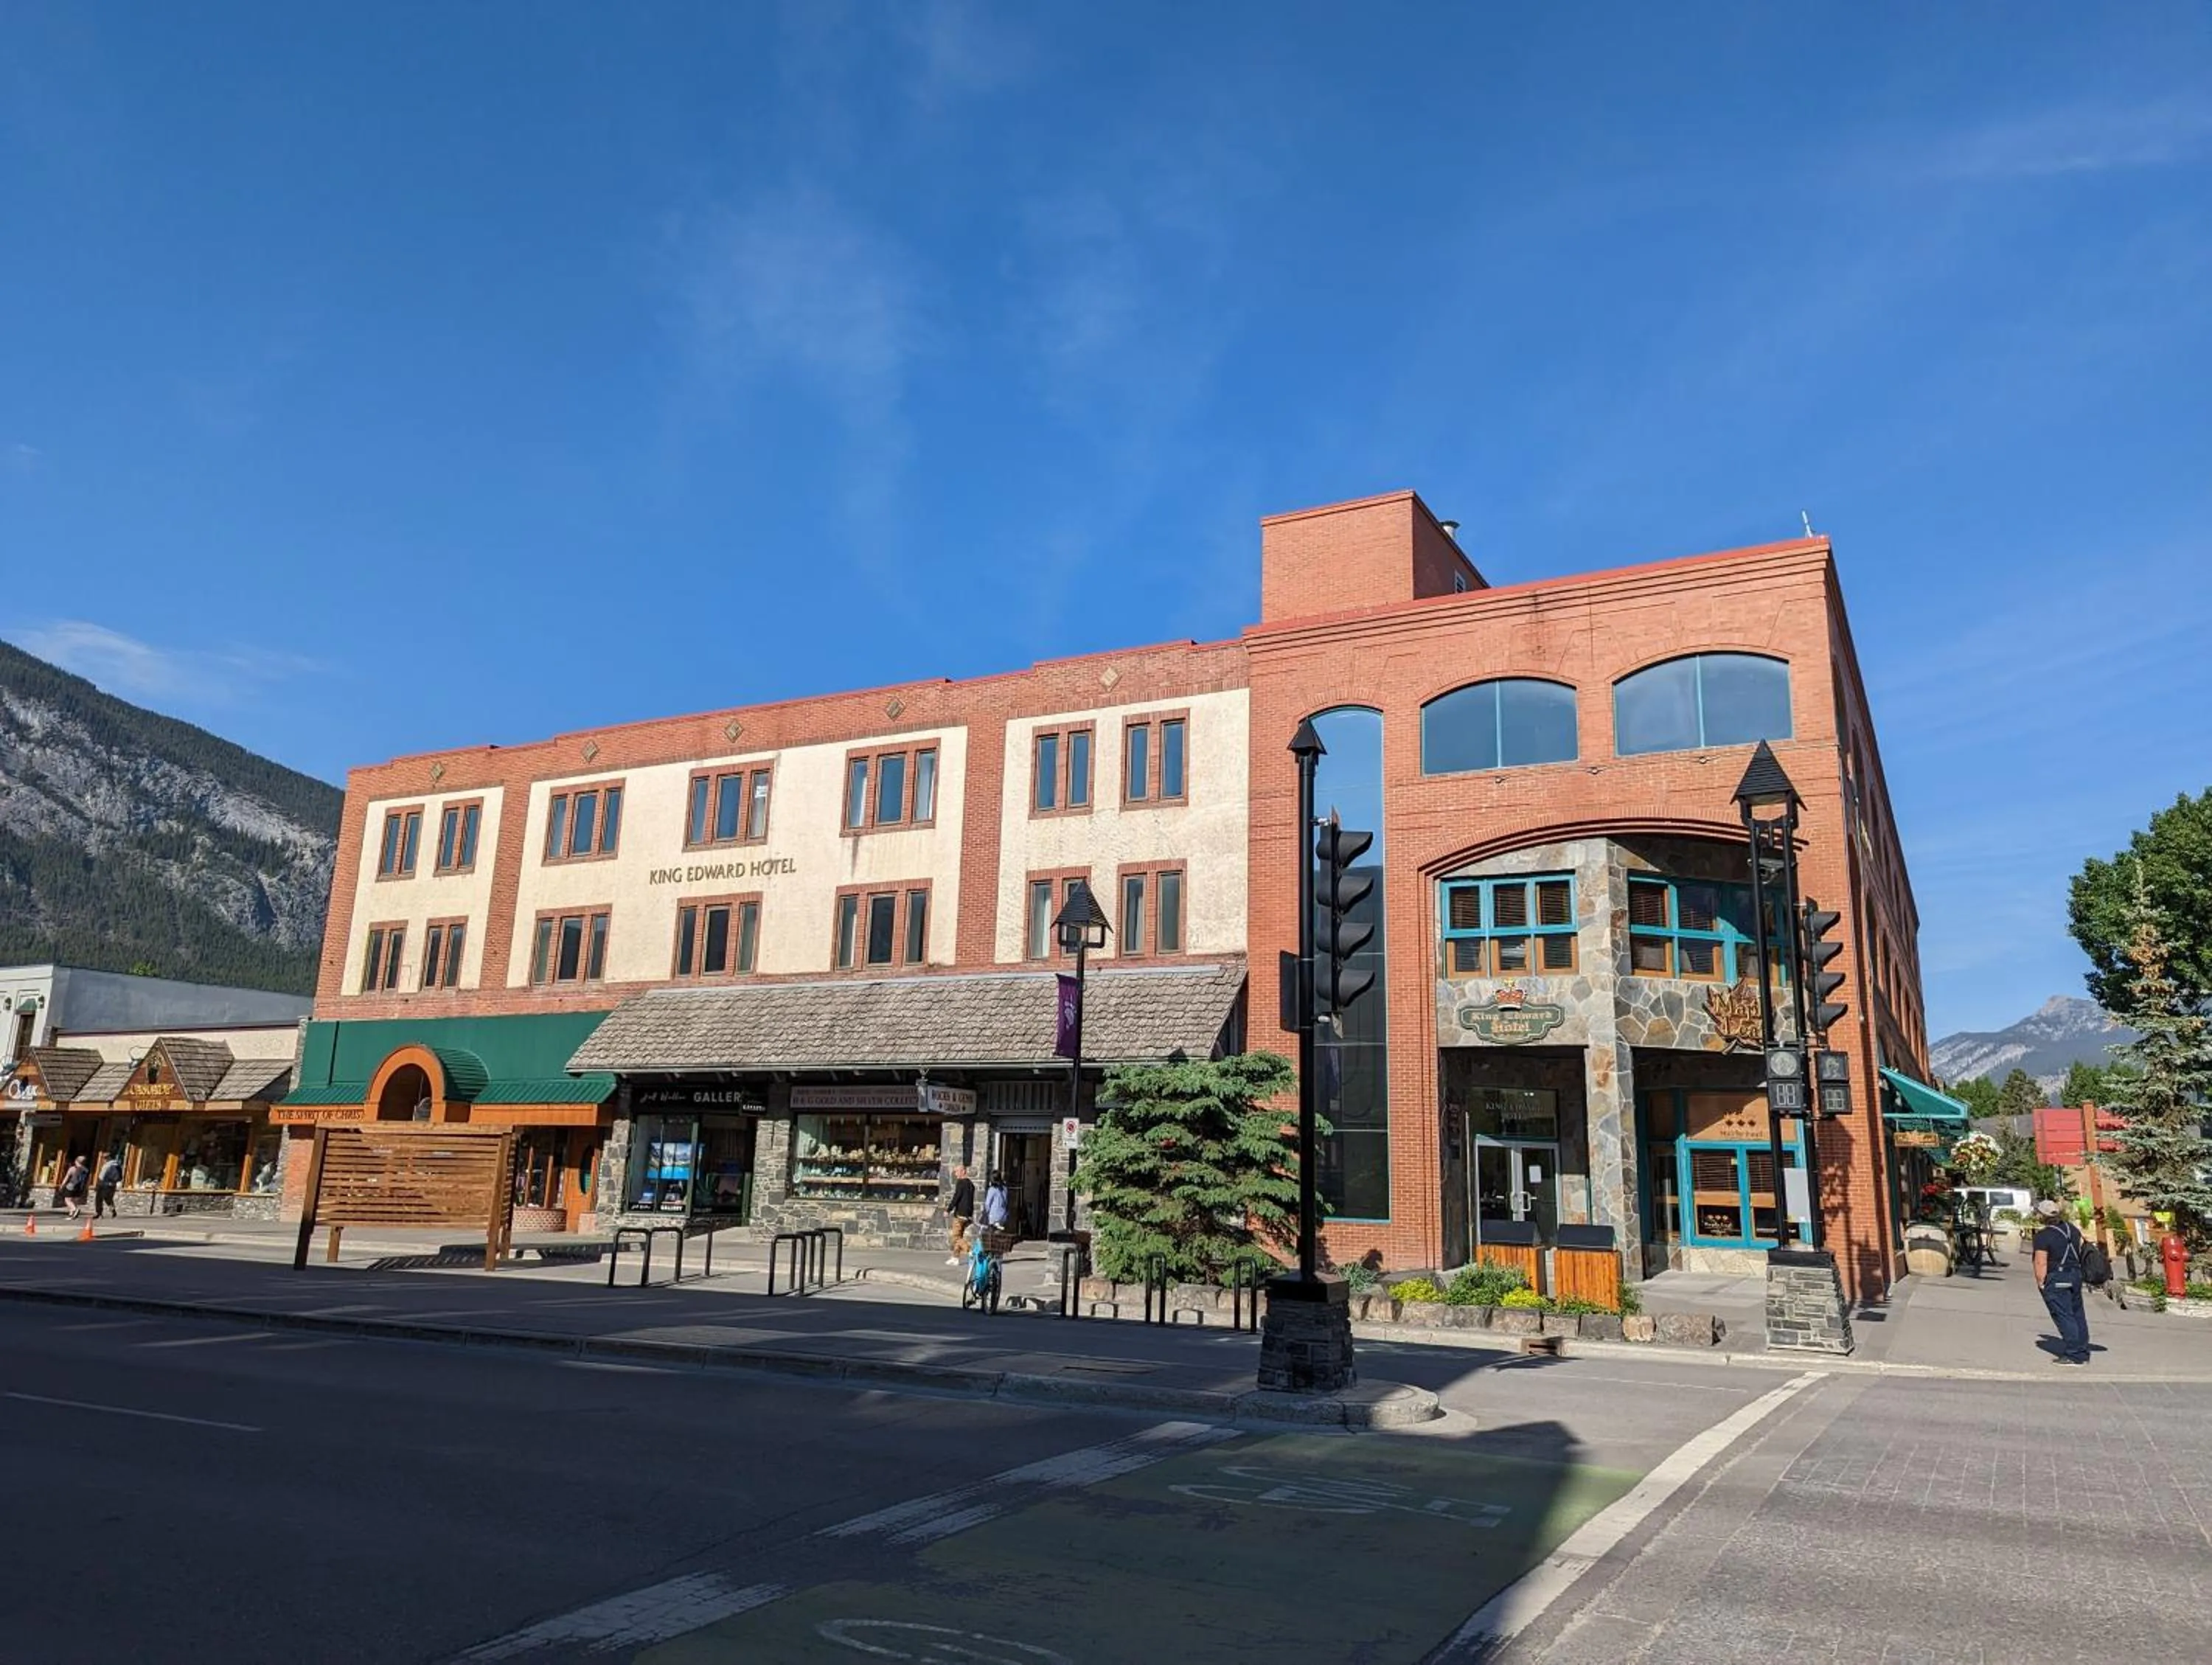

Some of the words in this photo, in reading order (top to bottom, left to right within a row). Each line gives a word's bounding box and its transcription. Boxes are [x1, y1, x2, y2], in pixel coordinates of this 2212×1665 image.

[650, 867, 683, 885] KING
[687, 862, 745, 882] EDWARD
[750, 858, 797, 877] HOTEL
[1722, 1017, 1761, 1037] Lea
[693, 1091, 743, 1102] GALLER
[277, 1109, 293, 1120] THE
[294, 1109, 321, 1120] SPIRIT
[322, 1109, 333, 1119] OF
